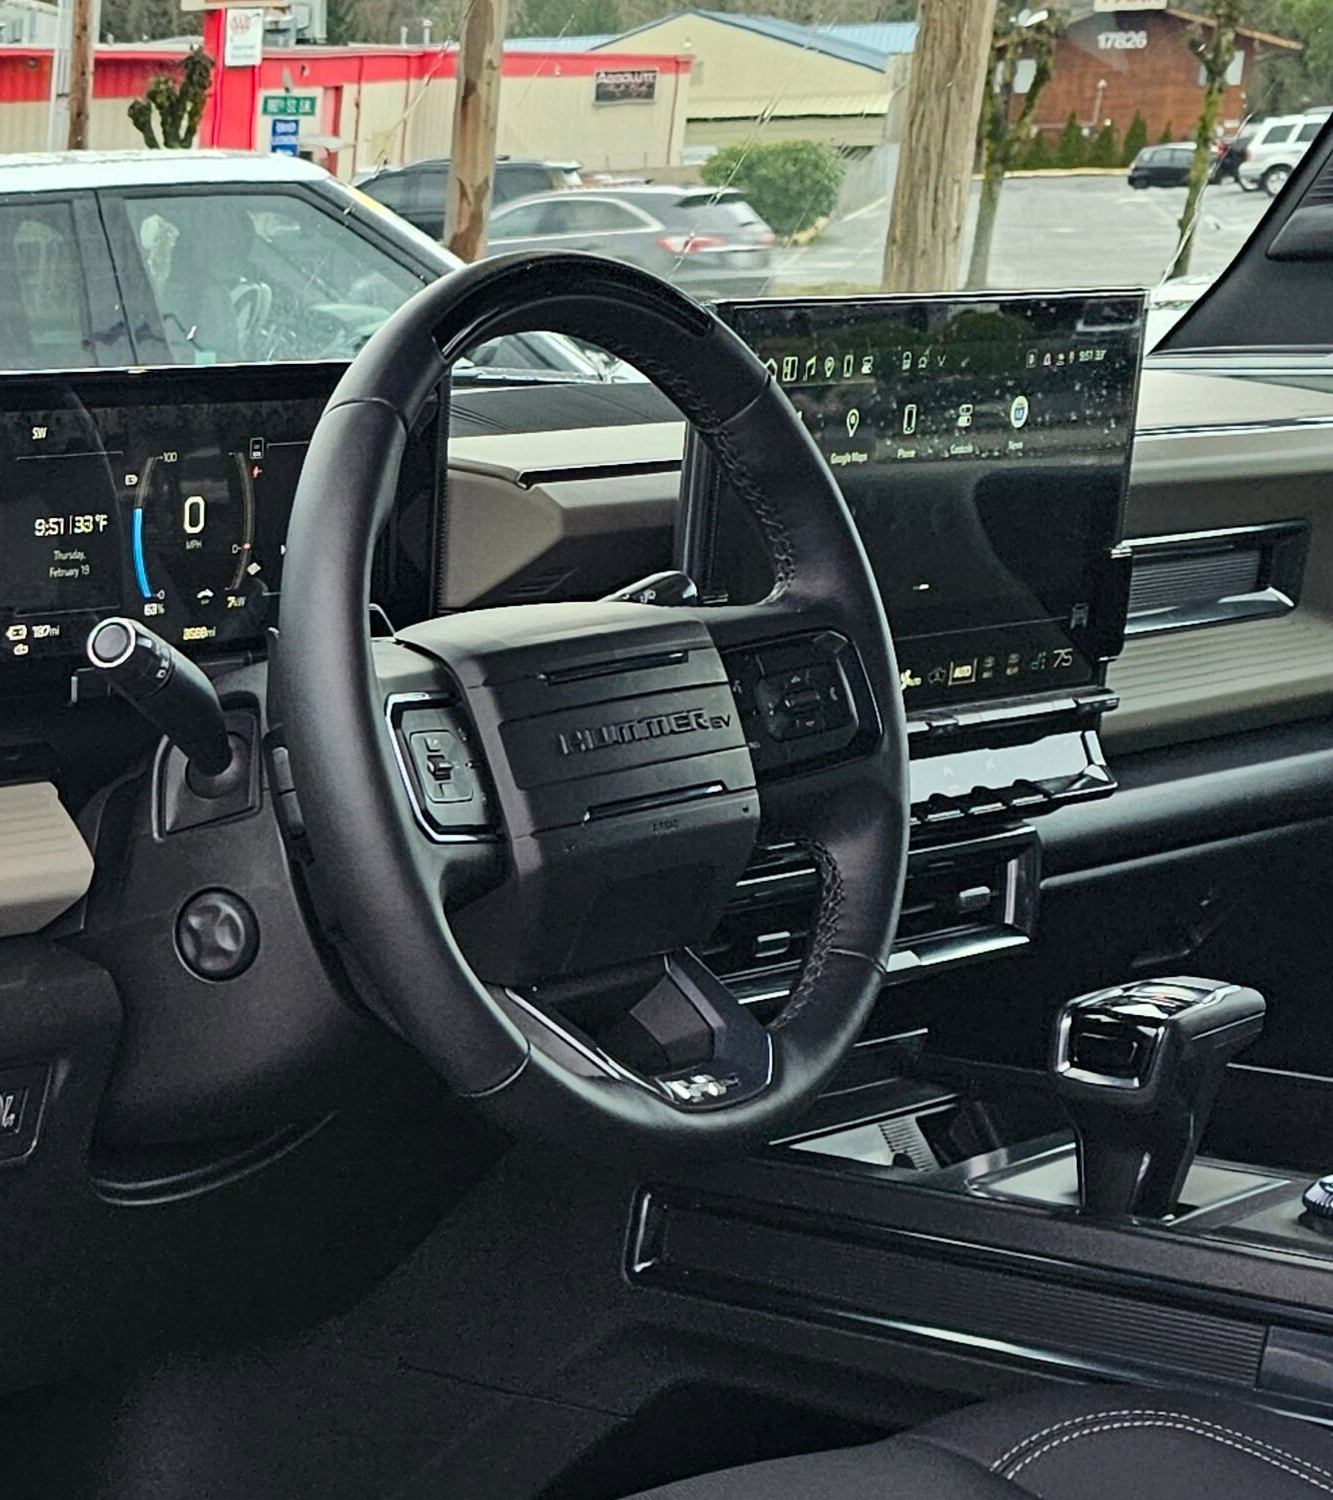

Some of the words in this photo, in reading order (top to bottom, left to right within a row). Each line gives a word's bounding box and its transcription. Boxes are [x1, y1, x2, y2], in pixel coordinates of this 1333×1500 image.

[32, 426, 48, 440] SW
[163, 452, 177, 463] 100
[183, 495, 205, 534] 0
[34, 518, 65, 537] 9:51
[186, 539, 202, 550] MPH
[1053, 648, 1073, 668] 75
[559, 709, 710, 755] HUMMER
[711, 714, 731, 729] EV
